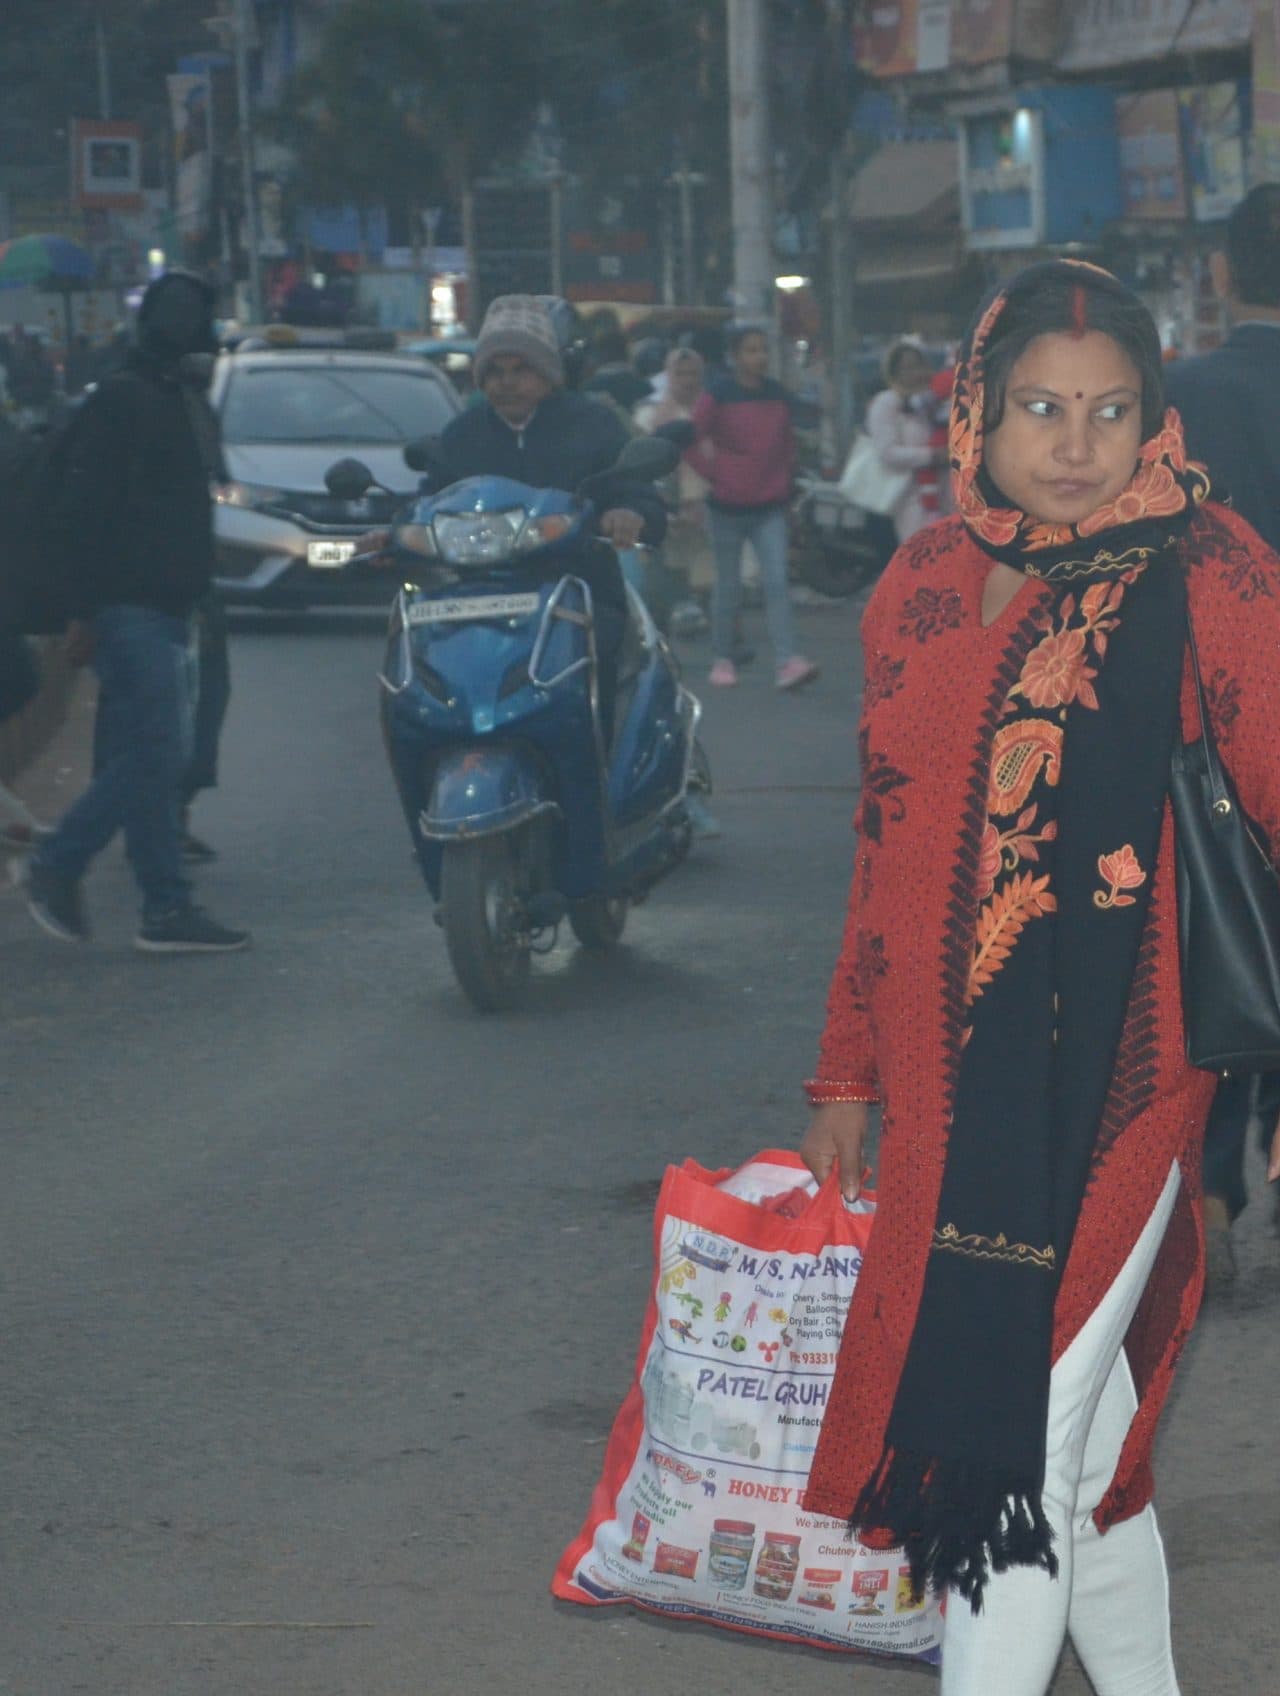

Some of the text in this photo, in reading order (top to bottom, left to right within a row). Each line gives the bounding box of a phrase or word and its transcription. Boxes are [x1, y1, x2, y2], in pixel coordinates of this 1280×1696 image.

[697, 1368, 827, 1407] PATEL GRUH
[727, 1478, 792, 1504] HONEY
[818, 1545, 857, 1559] Chutney
